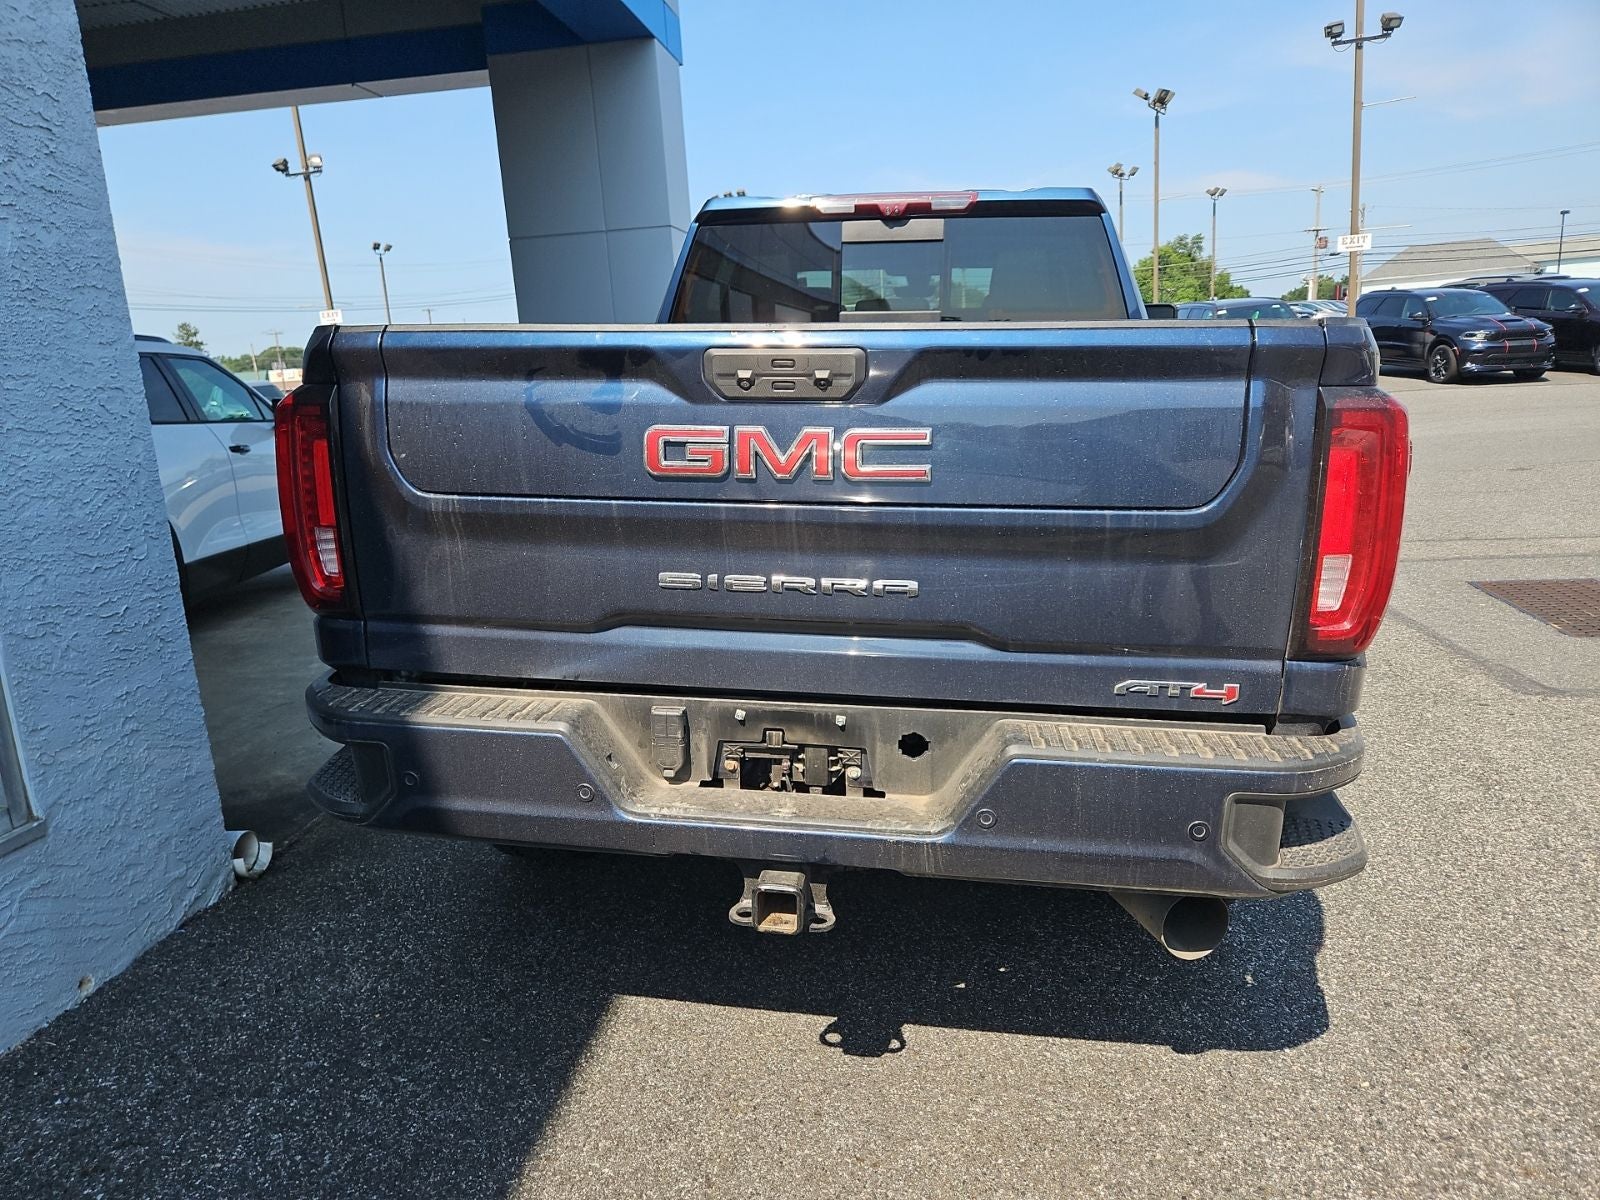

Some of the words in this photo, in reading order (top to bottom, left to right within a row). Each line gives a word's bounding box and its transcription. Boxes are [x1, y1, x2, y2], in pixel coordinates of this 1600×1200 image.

[1341, 235, 1368, 246] EXIT
[643, 424, 933, 483] GMC
[658, 571, 919, 598] SIERRA
[1113, 679, 1240, 705] AT4
